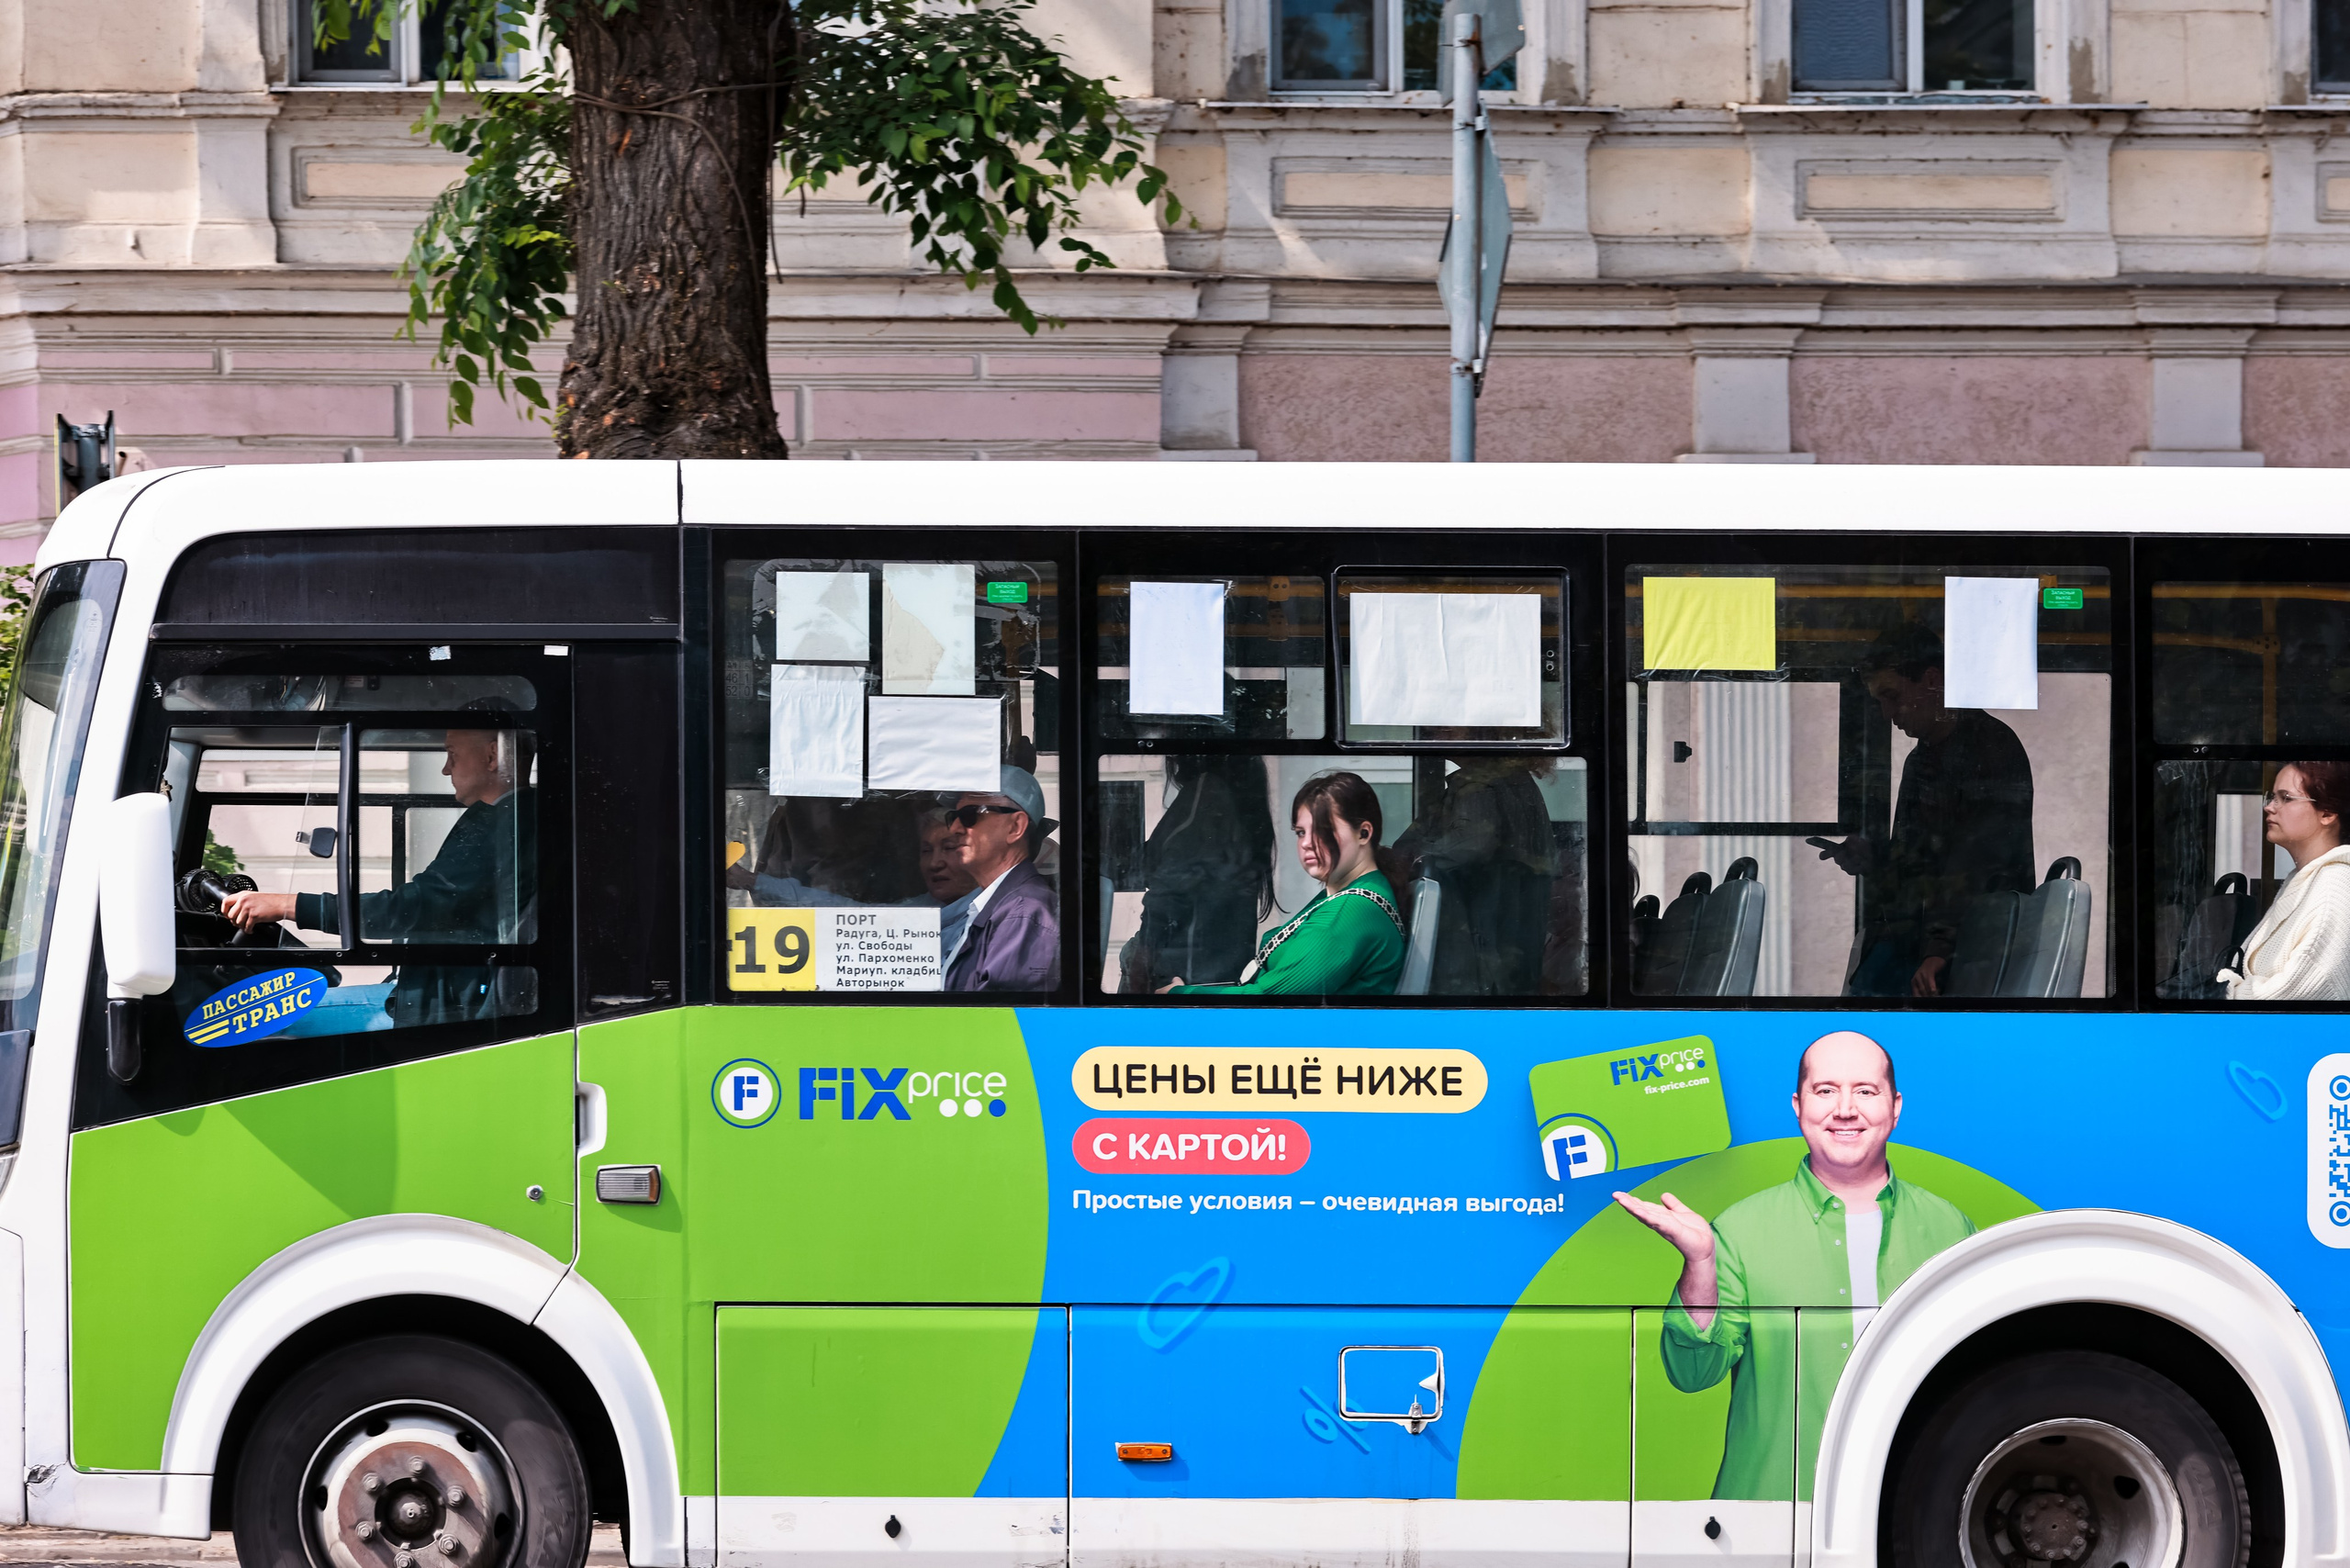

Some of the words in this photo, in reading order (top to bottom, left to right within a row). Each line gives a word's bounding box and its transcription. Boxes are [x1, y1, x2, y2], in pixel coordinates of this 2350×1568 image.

[836, 914, 877, 925] ПОРТ
[836, 928, 882, 939] Радуга,
[887, 928, 899, 939] Ц.
[836, 942, 854, 951] ул.
[858, 941, 912, 951] Свободы
[836, 955, 854, 964] ул.
[858, 954, 934, 964] Пархоменко
[836, 966, 887, 977] Мариуп.
[836, 978, 904, 989] Авторынок
[202, 971, 296, 1020] ПАССАЖИР
[232, 987, 312, 1034] ТРАНС
[908, 1071, 1008, 1103] price
[1093, 1063, 1214, 1098] ЦЕНЫ
[1231, 1057, 1322, 1100] ЕЩЁ
[1337, 1064, 1462, 1096] НИЖЕ
[1644, 1076, 1710, 1094] fix-price.com
[733, 1076, 759, 1111] F
[1092, 1133, 1117, 1160] С
[1128, 1126, 1287, 1161] КАРТОЙ!
[1072, 1190, 1182, 1214] Простые
[1189, 1194, 1292, 1215] условия
[1322, 1195, 1458, 1215] очевидная
[1465, 1193, 1564, 1215] выгода!
